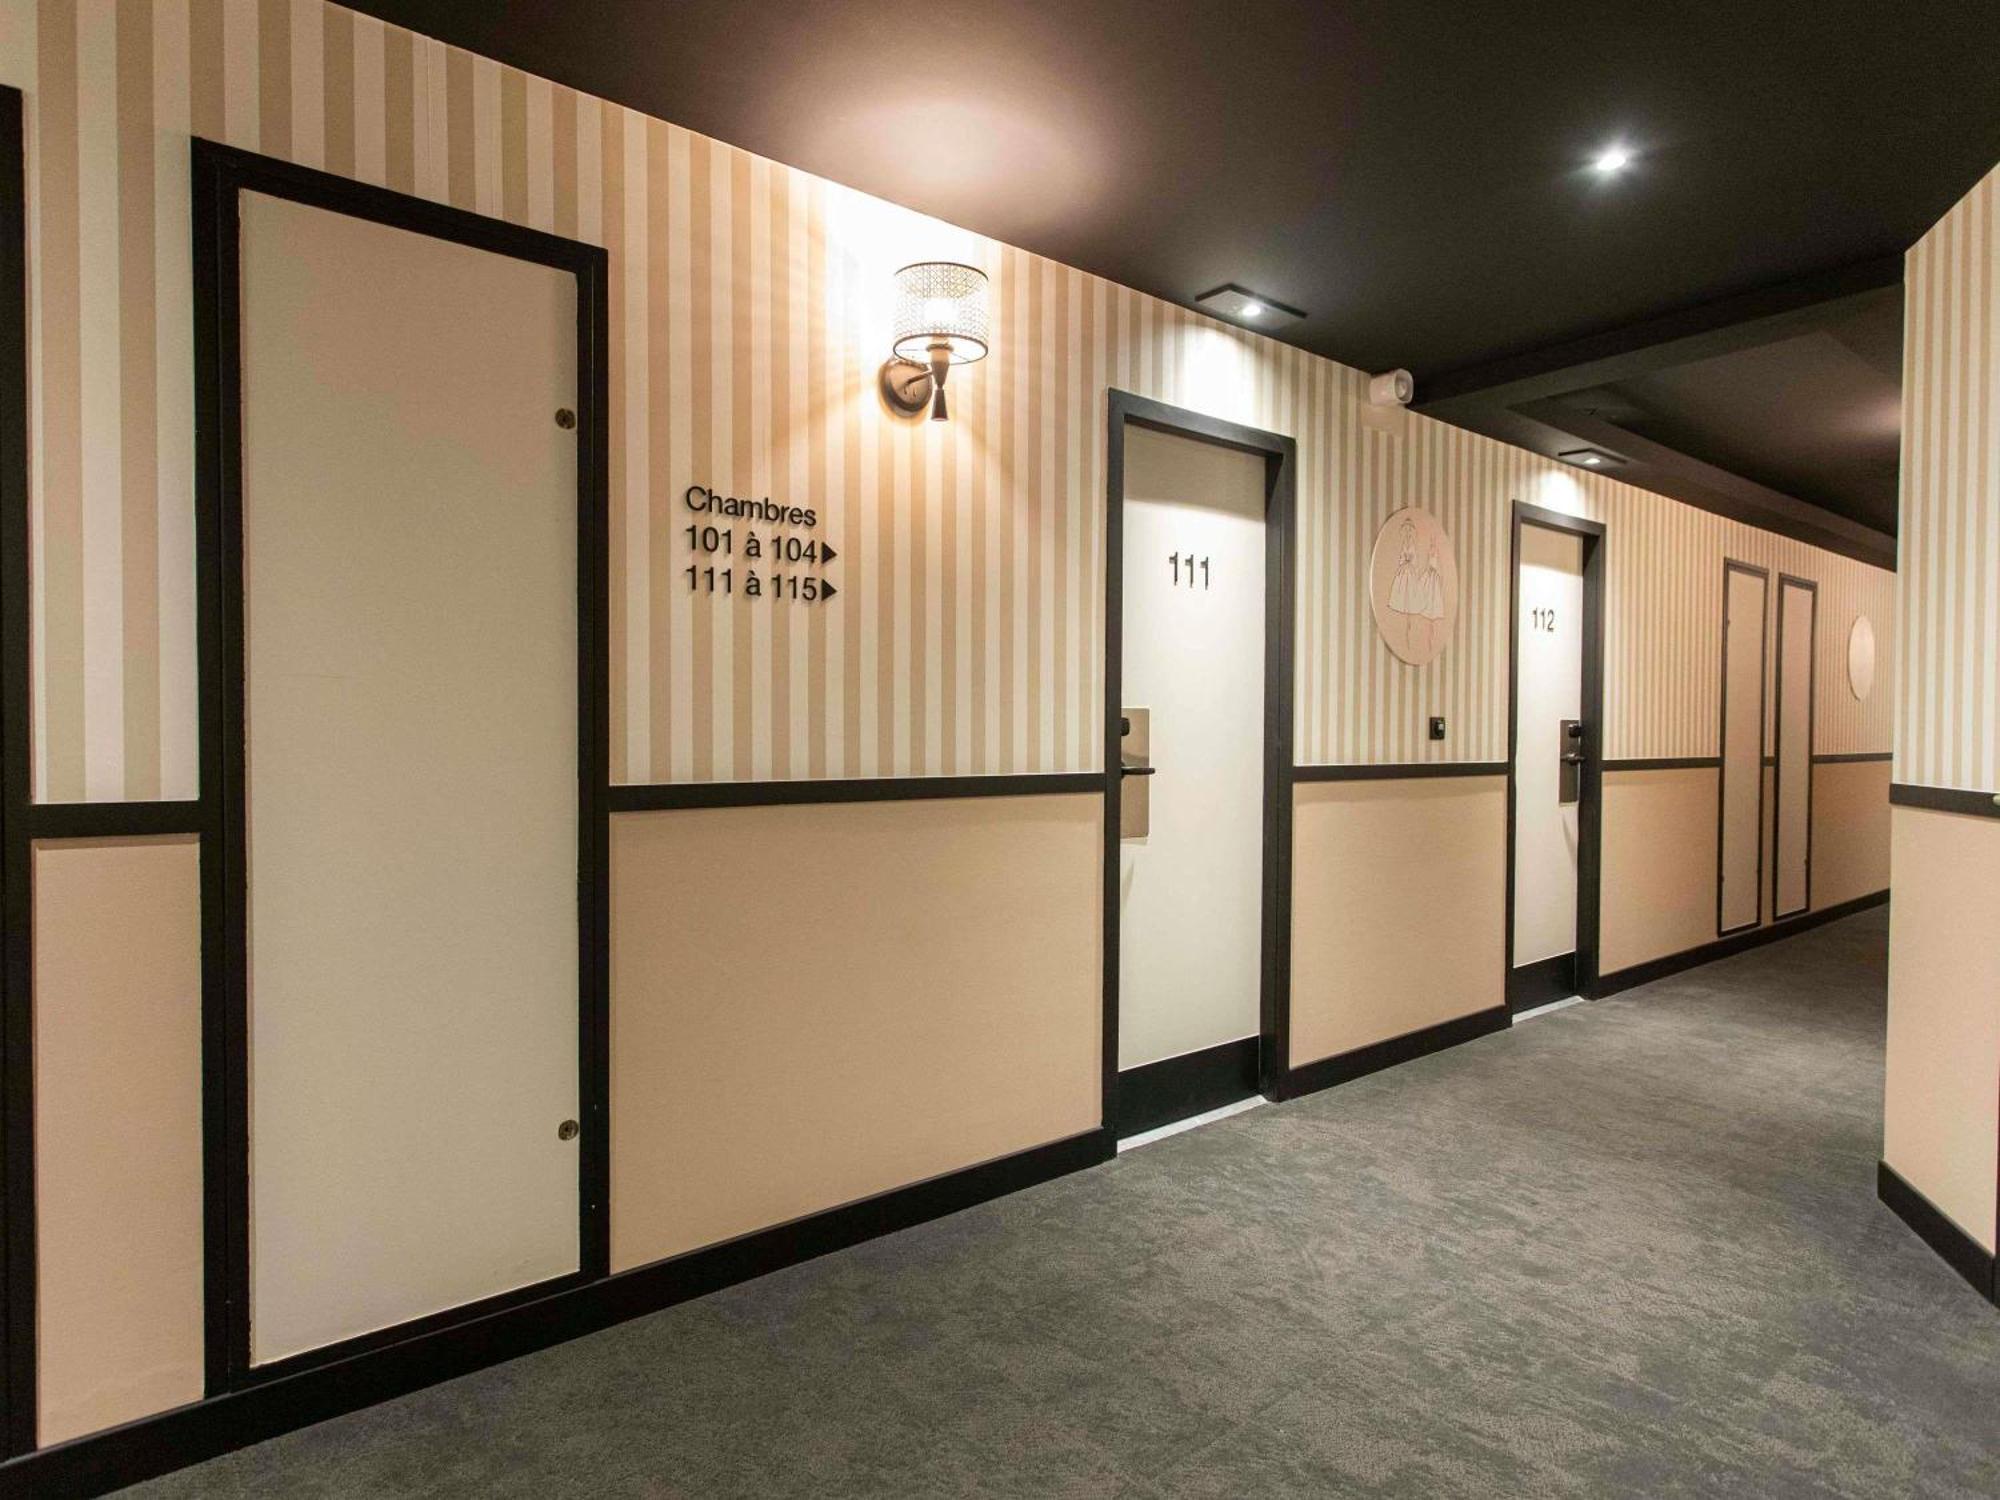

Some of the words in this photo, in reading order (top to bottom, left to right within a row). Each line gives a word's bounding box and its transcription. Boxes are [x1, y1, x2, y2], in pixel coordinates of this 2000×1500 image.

[685, 485, 817, 527] Chambres
[685, 524, 732, 555] 101
[746, 531, 762, 558] à
[771, 535, 817, 564] 104
[685, 565, 732, 594] 111
[746, 570, 762, 597] à
[771, 574, 817, 601] 115
[1169, 551, 1209, 591] 111
[1532, 607, 1555, 632] 112
